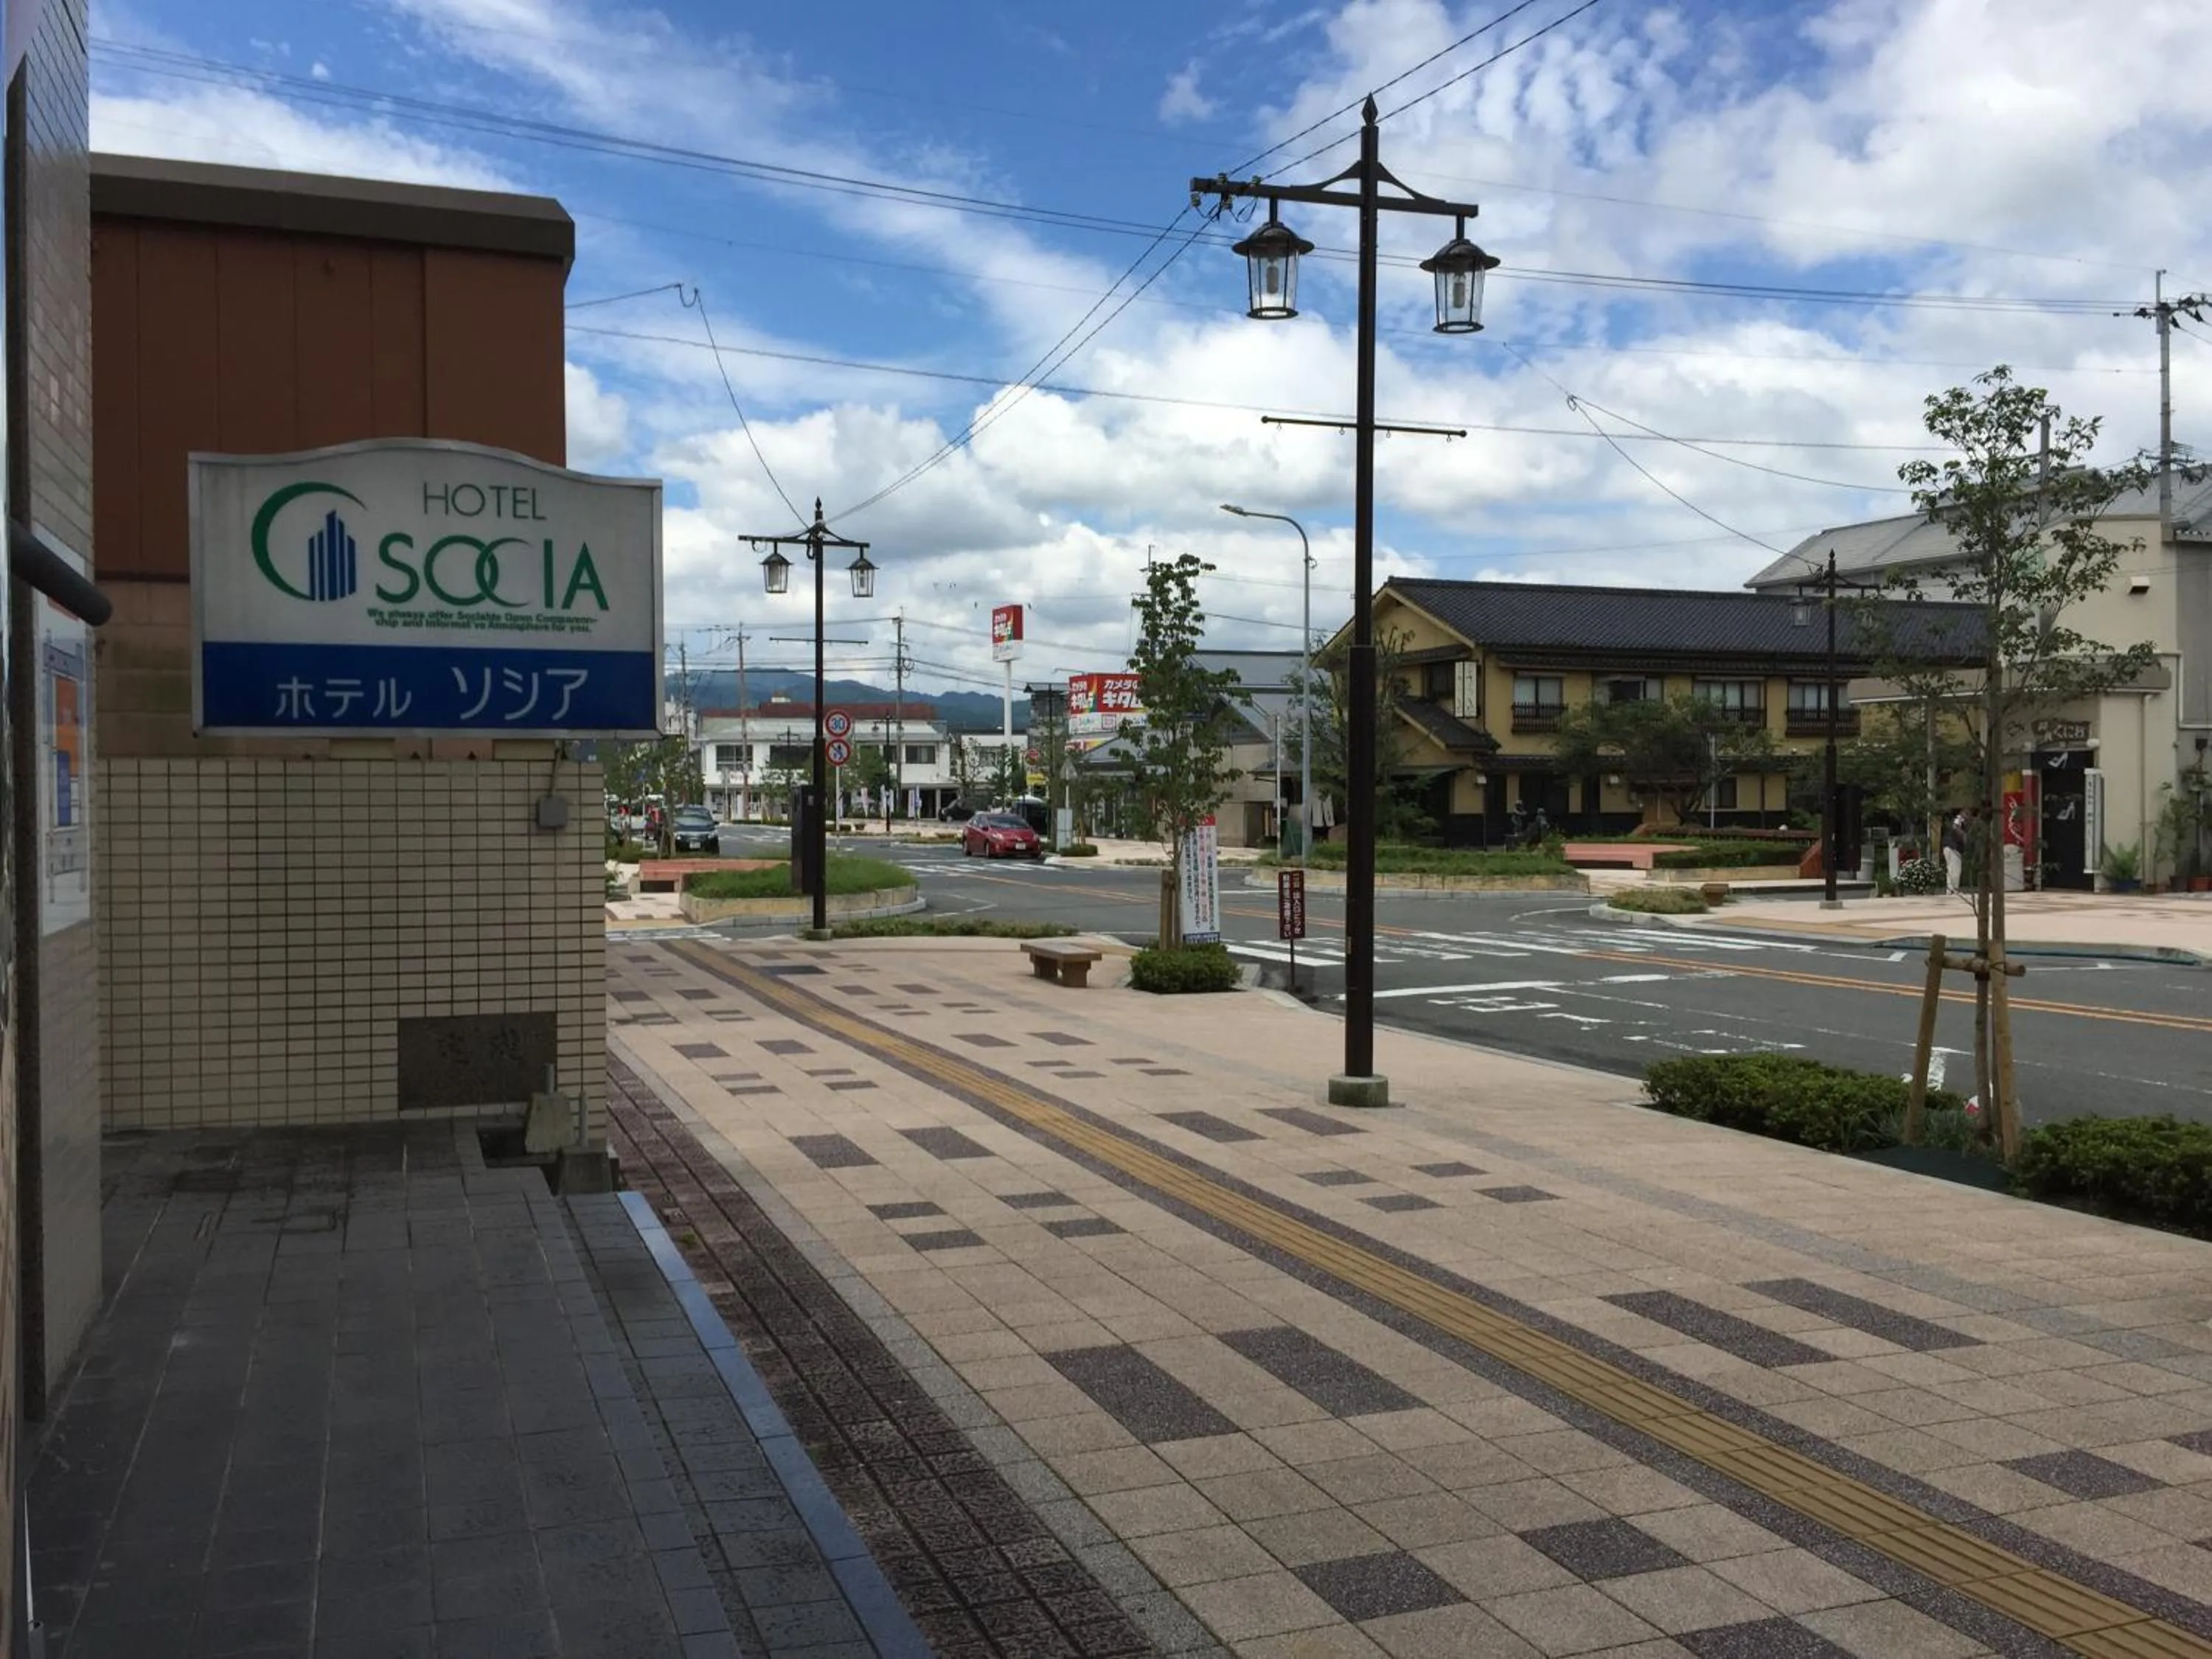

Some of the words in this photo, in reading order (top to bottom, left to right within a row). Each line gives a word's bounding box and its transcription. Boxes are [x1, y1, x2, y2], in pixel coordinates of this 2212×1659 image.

[422, 481, 548, 520] HOTEL
[375, 532, 610, 611] SOCIA
[403, 618, 422, 627] and
[552, 623, 566, 632] for
[274, 676, 412, 720] ホテル
[451, 666, 589, 721] ソシア
[831, 717, 846, 730] 30
